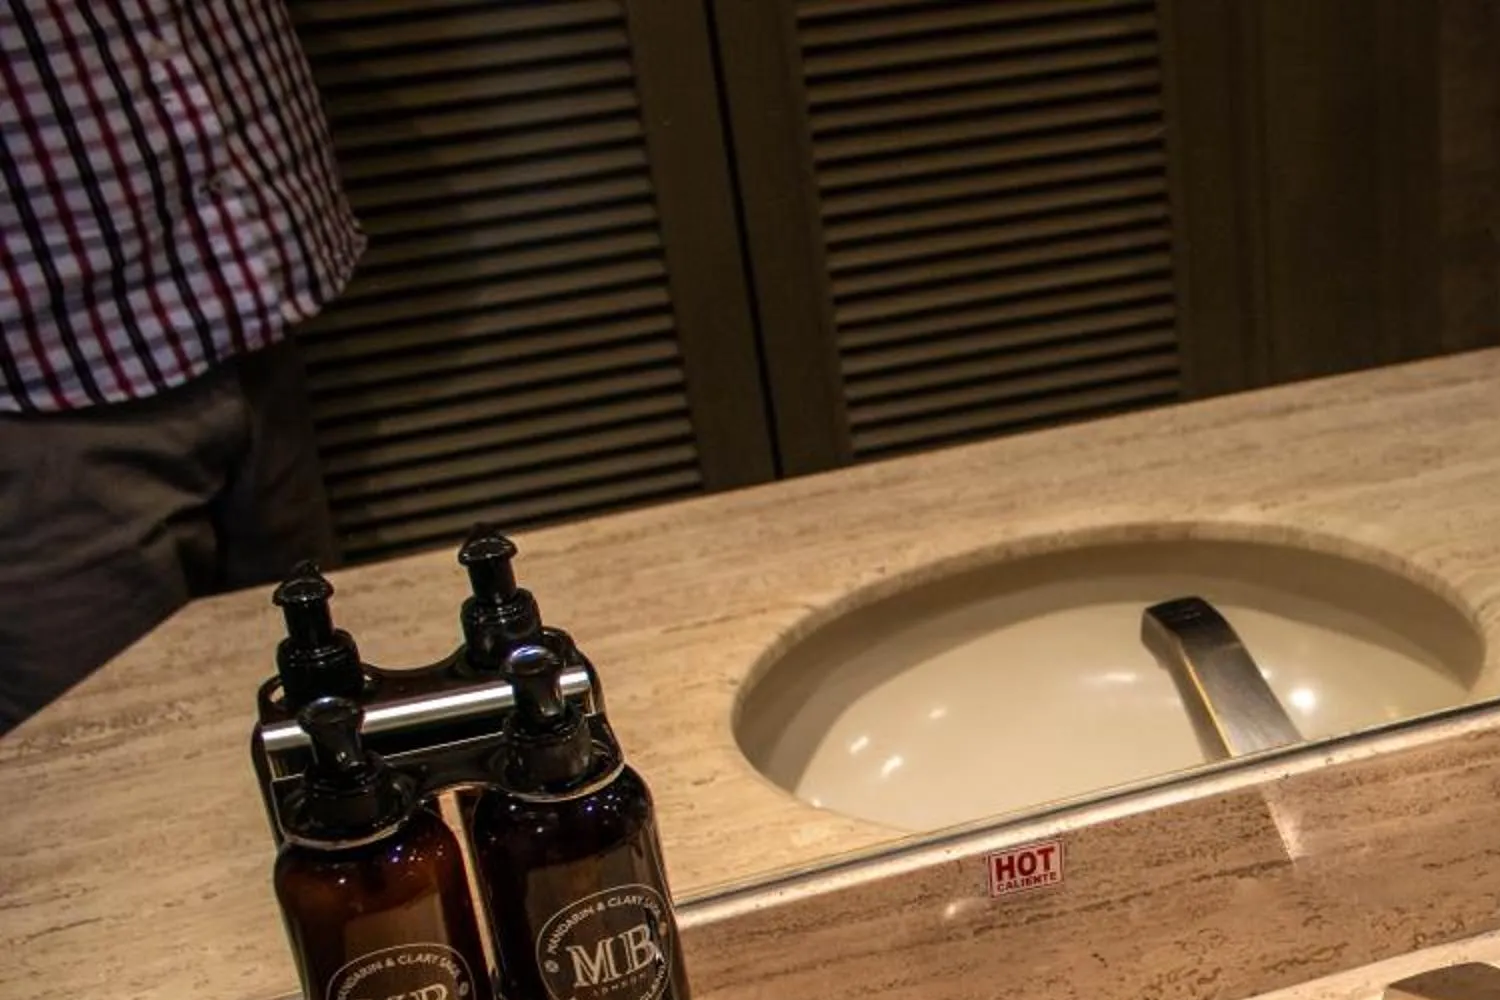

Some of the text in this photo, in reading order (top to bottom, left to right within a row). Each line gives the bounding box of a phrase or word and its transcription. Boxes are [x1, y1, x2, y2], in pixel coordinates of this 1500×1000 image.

[996, 846, 1055, 881] HOT
[997, 871, 1056, 892] CALIENTE
[565, 923, 658, 988] MB
